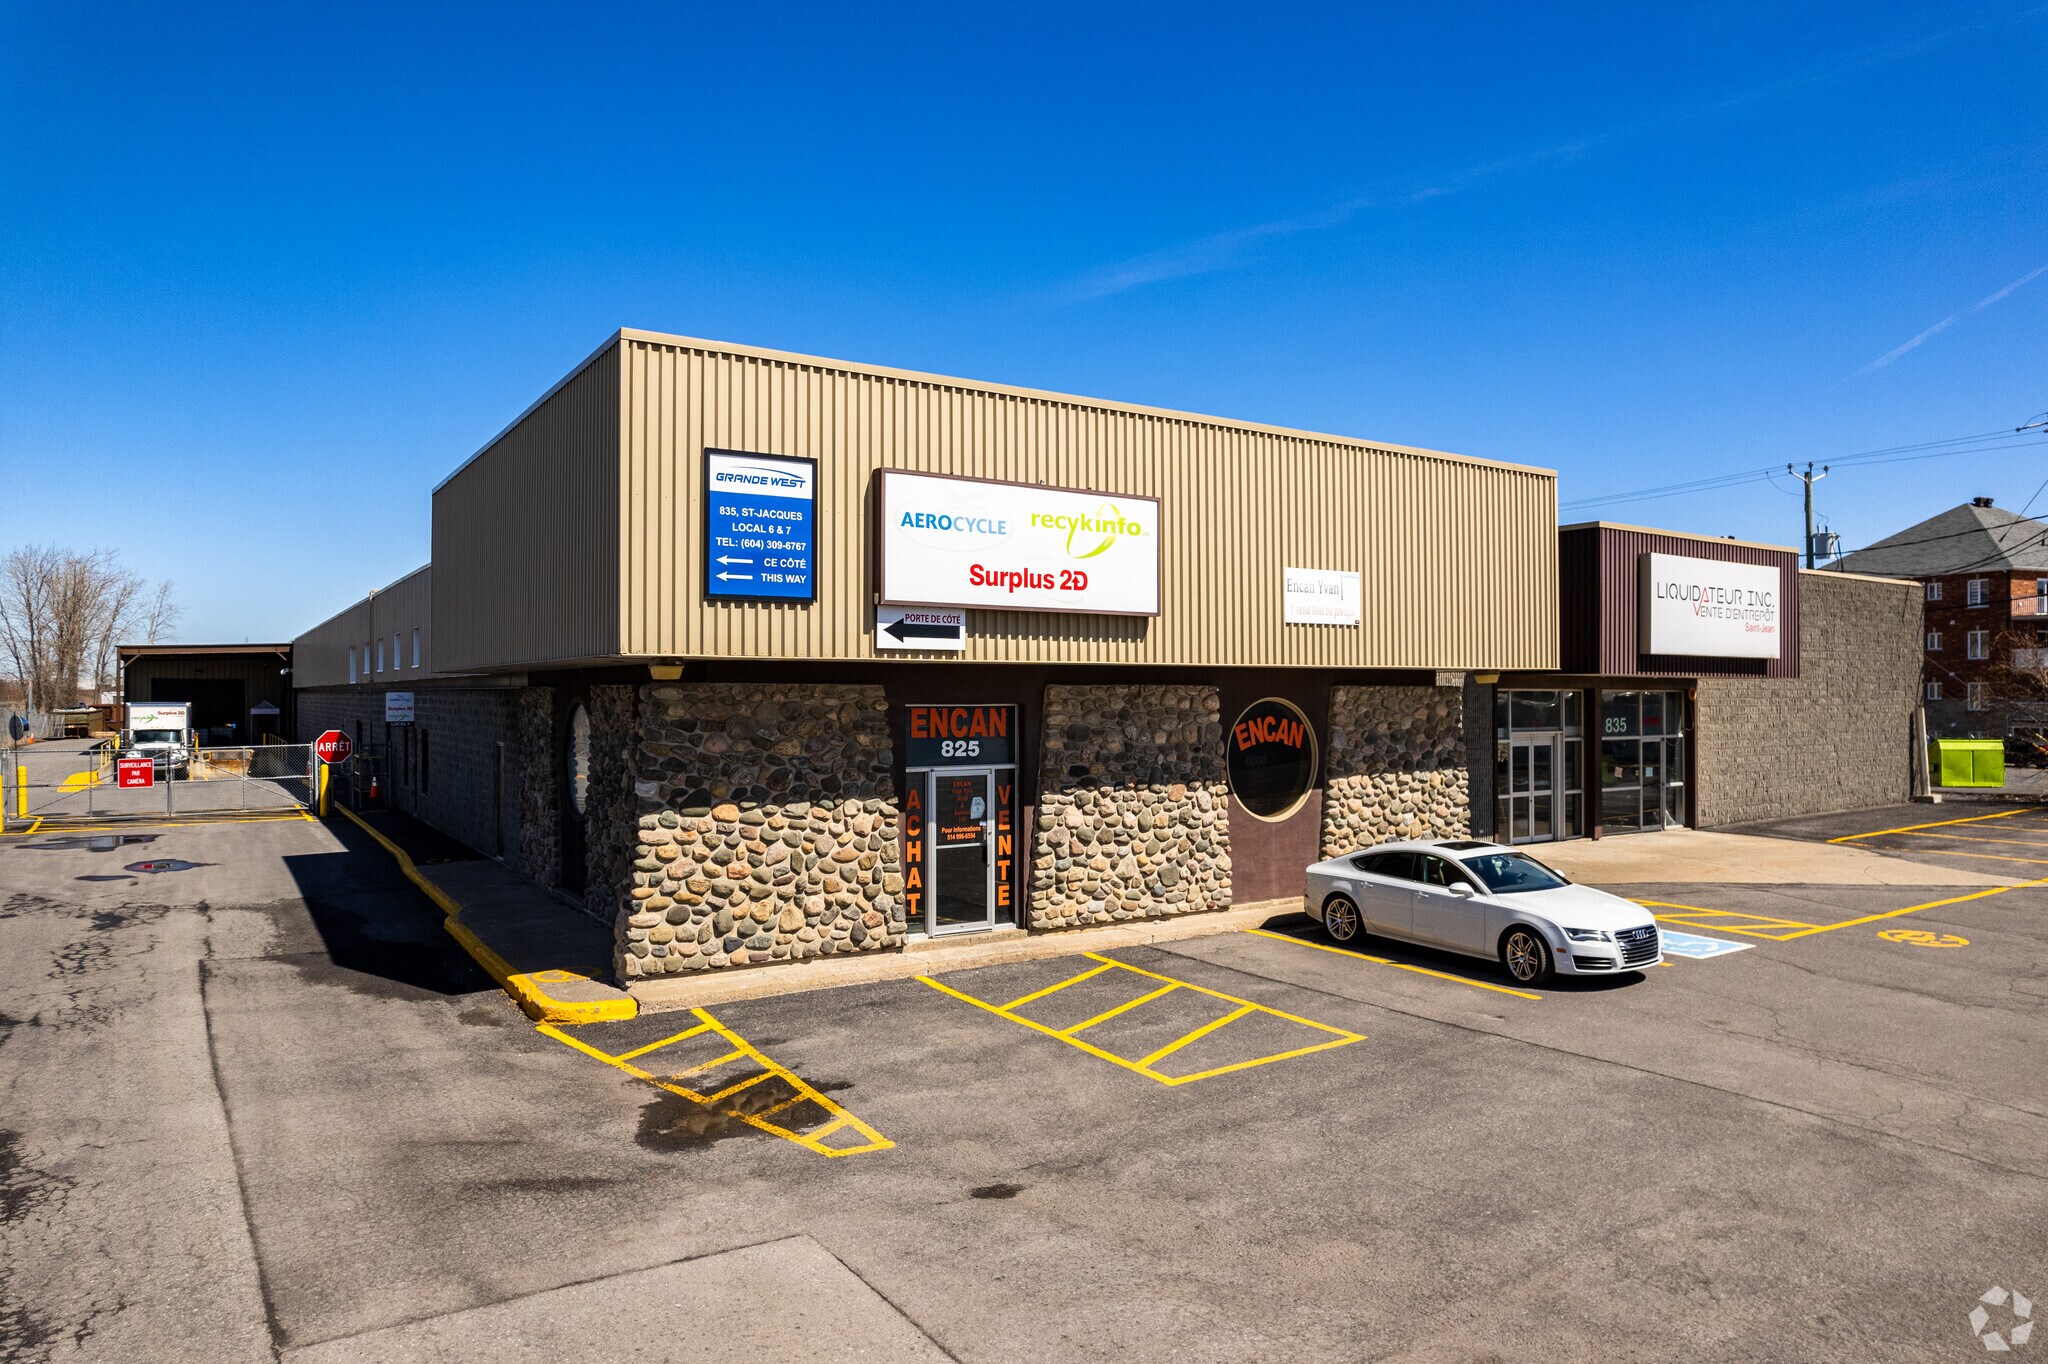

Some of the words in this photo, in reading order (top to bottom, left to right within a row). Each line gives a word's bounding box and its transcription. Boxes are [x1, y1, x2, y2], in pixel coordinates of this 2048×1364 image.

[716, 472, 768, 485] GRANDE
[771, 477, 806, 488] WEST
[719, 506, 739, 518] 835,
[741, 507, 803, 521] ST-JACQUES
[732, 523, 766, 533] LOCAL
[768, 525, 774, 534] 6
[776, 526, 784, 534] &
[786, 526, 792, 535] 7
[900, 511, 1007, 535] AEROCYCLE
[716, 537, 739, 547] TEL:
[741, 538, 764, 550] (604)
[766, 540, 807, 551] 309-6767
[764, 558, 778, 567] CE
[780, 554, 807, 569] CÔTÉ
[761, 573, 783, 583] THIS
[785, 574, 807, 584] WAY
[969, 563, 1055, 594] Surplus
[1059, 569, 1088, 591] 2D
[1286, 578, 1315, 594] Encan
[1317, 579, 1340, 595] Yvan
[1657, 581, 1743, 606] LIQUIDATEUR
[1747, 590, 1775, 608] INC.
[905, 613, 929, 623] PORTE
[930, 614, 941, 624] DE
[942, 612, 961, 625] CÔTÉ
[1692, 602, 1723, 619] VENTE
[1725, 608, 1775, 622] D'ENTREPÔT
[1745, 622, 1775, 634] Saint-Jean
[910, 707, 1007, 739] ENCAN
[1605, 717, 1627, 733] 835
[1234, 716, 1305, 752] ENCAN
[318, 740, 350, 752] ARRÊT
[941, 740, 980, 757] 825
[953, 825, 982, 833] informations
[906, 788, 922, 915] ACHAT
[997, 784, 1012, 907] VENTE
